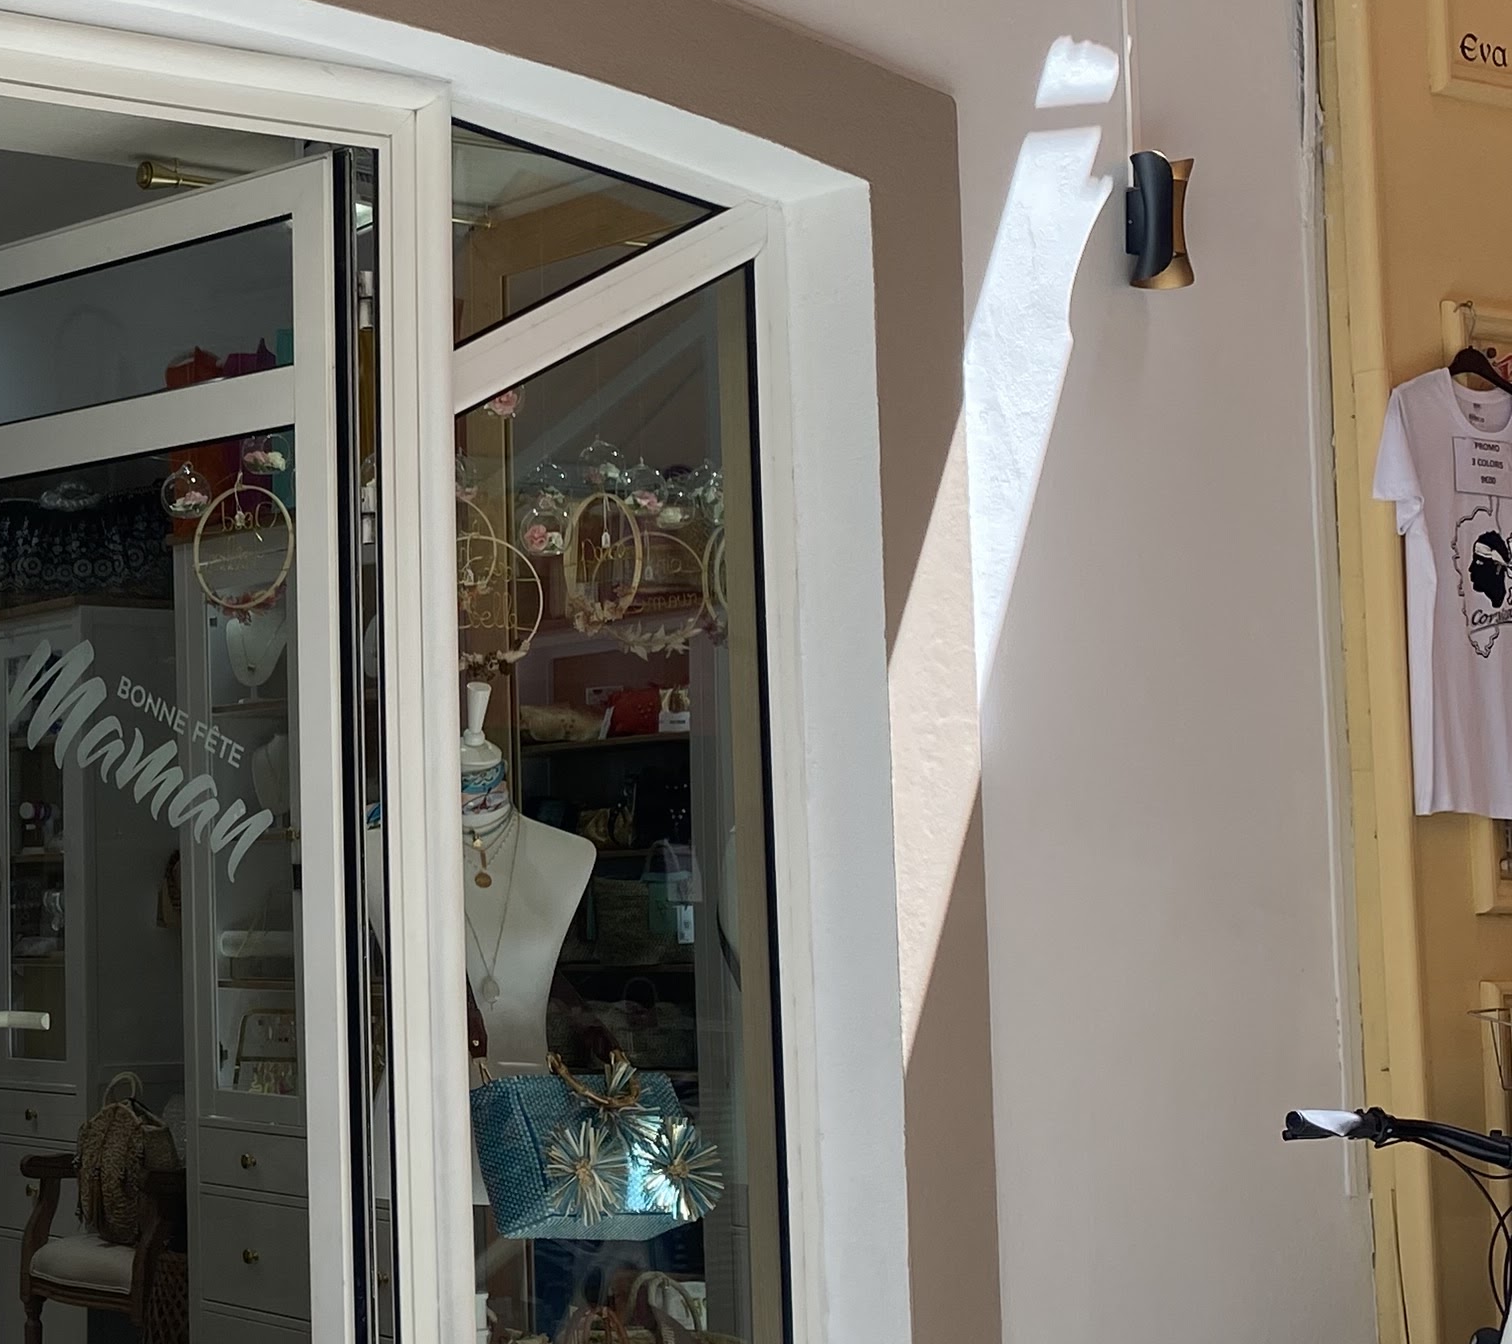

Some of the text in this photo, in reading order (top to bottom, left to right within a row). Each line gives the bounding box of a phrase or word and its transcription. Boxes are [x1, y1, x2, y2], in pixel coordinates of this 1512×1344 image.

[1459, 32, 1508, 68] Eva
[9, 639, 274, 884] Maman
[117, 675, 245, 768] BONNE FÊTE
